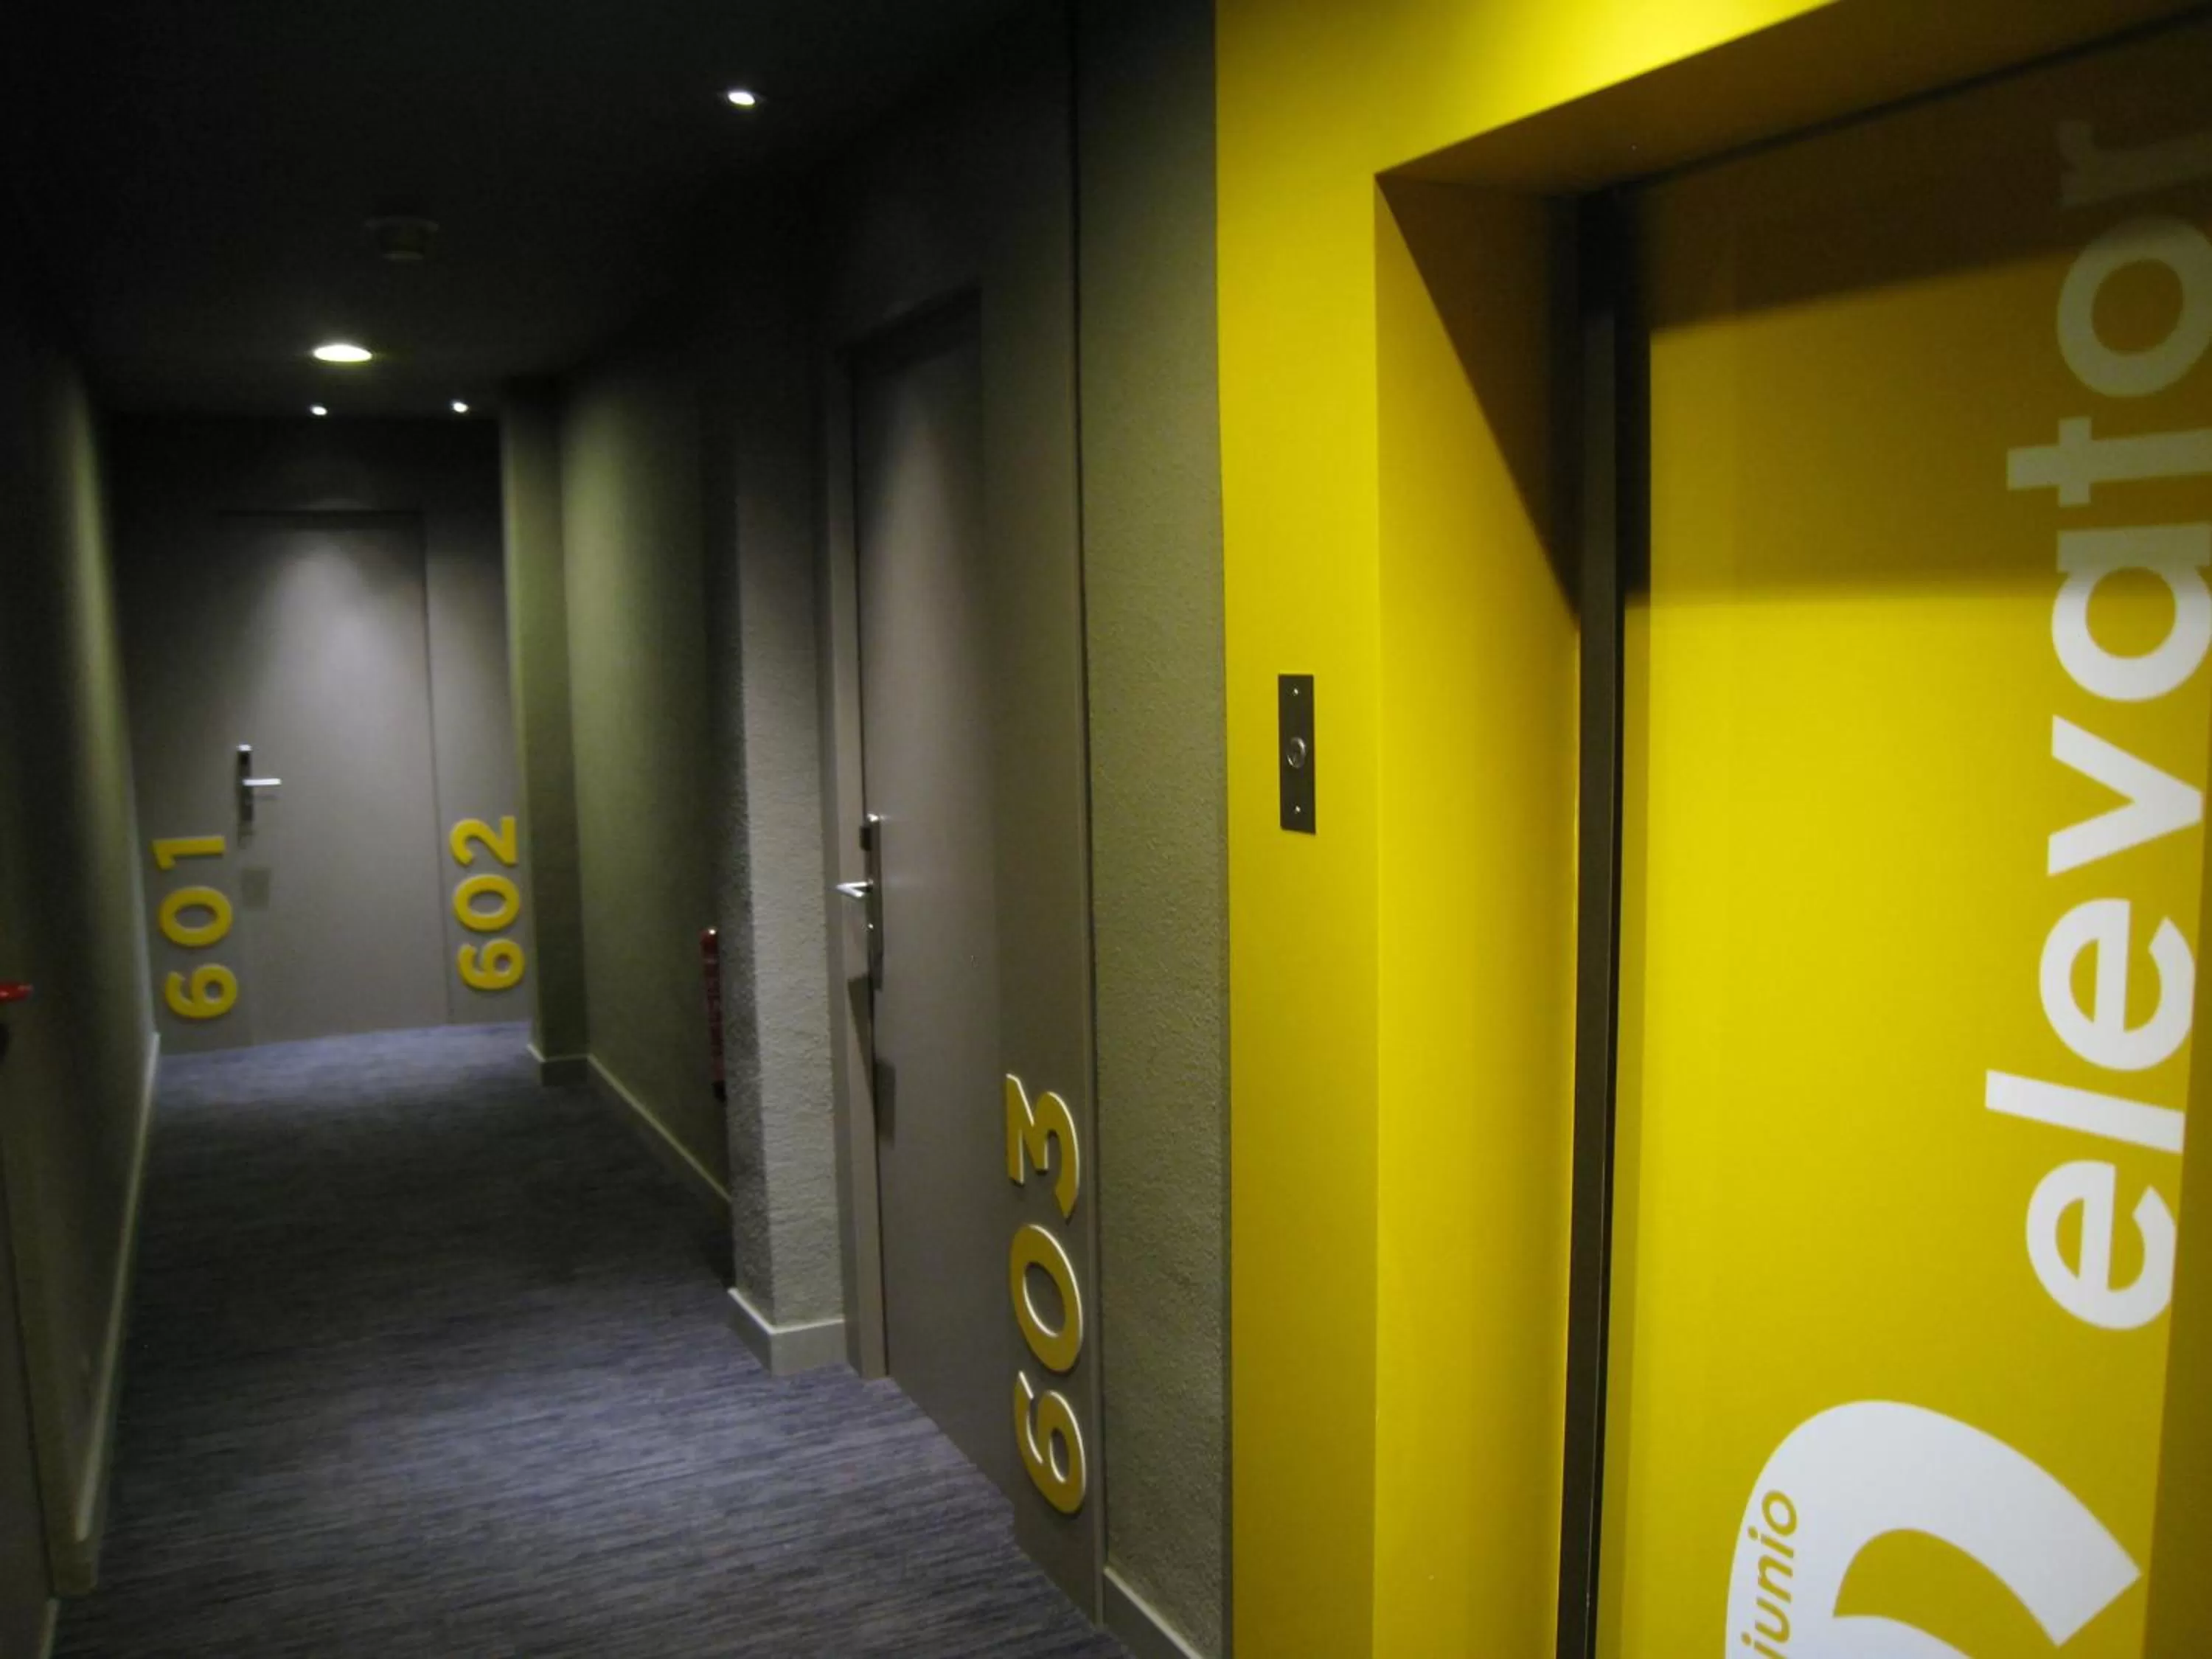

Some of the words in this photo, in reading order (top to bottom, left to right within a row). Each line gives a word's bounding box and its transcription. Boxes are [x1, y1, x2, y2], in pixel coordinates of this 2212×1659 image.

[1985, 120, 2212, 1329] elevator
[153, 835, 237, 1019] 601
[449, 816, 526, 990] 602
[1006, 1074, 1086, 1514] 603
